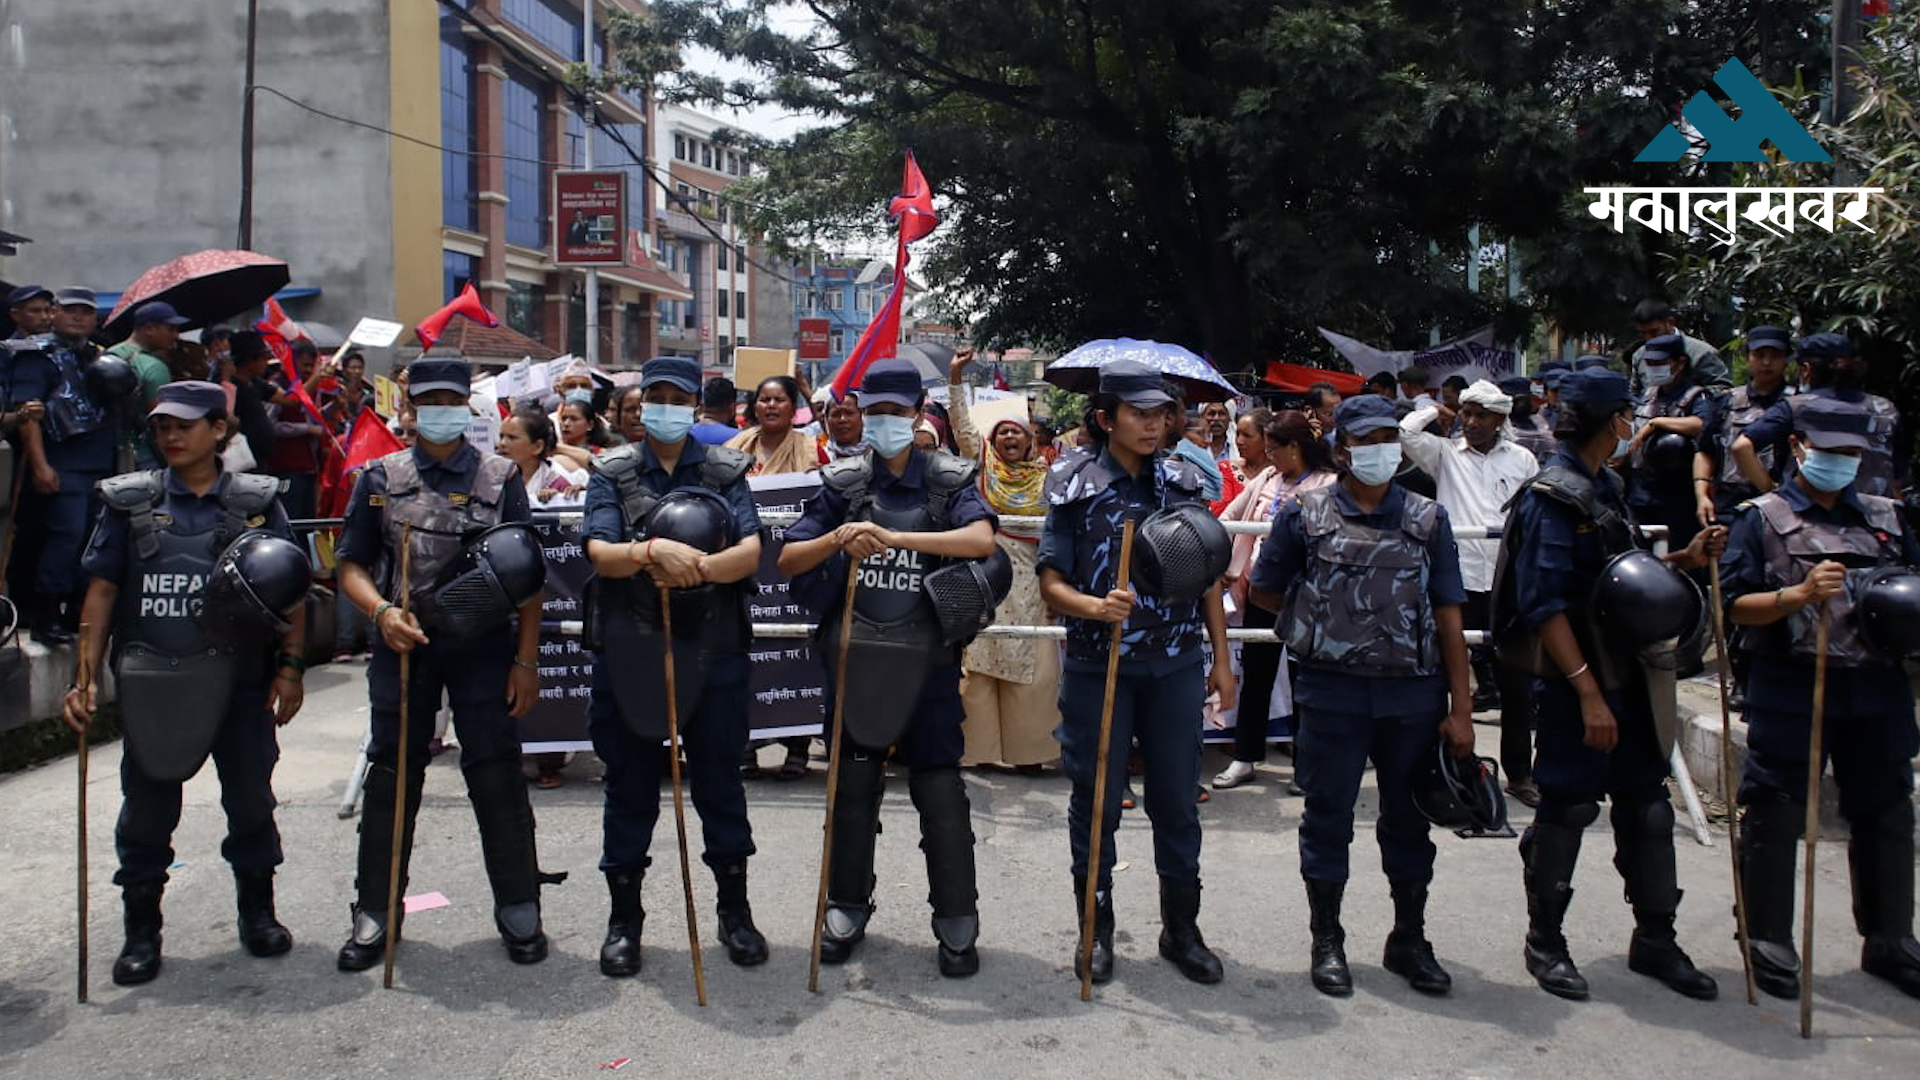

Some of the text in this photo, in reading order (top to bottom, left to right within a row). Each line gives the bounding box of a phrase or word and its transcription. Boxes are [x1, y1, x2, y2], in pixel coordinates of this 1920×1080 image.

[862, 547, 922, 570] EPAL
[142, 574, 211, 593] NEPA
[856, 568, 921, 593] POLICE
[141, 598, 203, 617] POLIC
